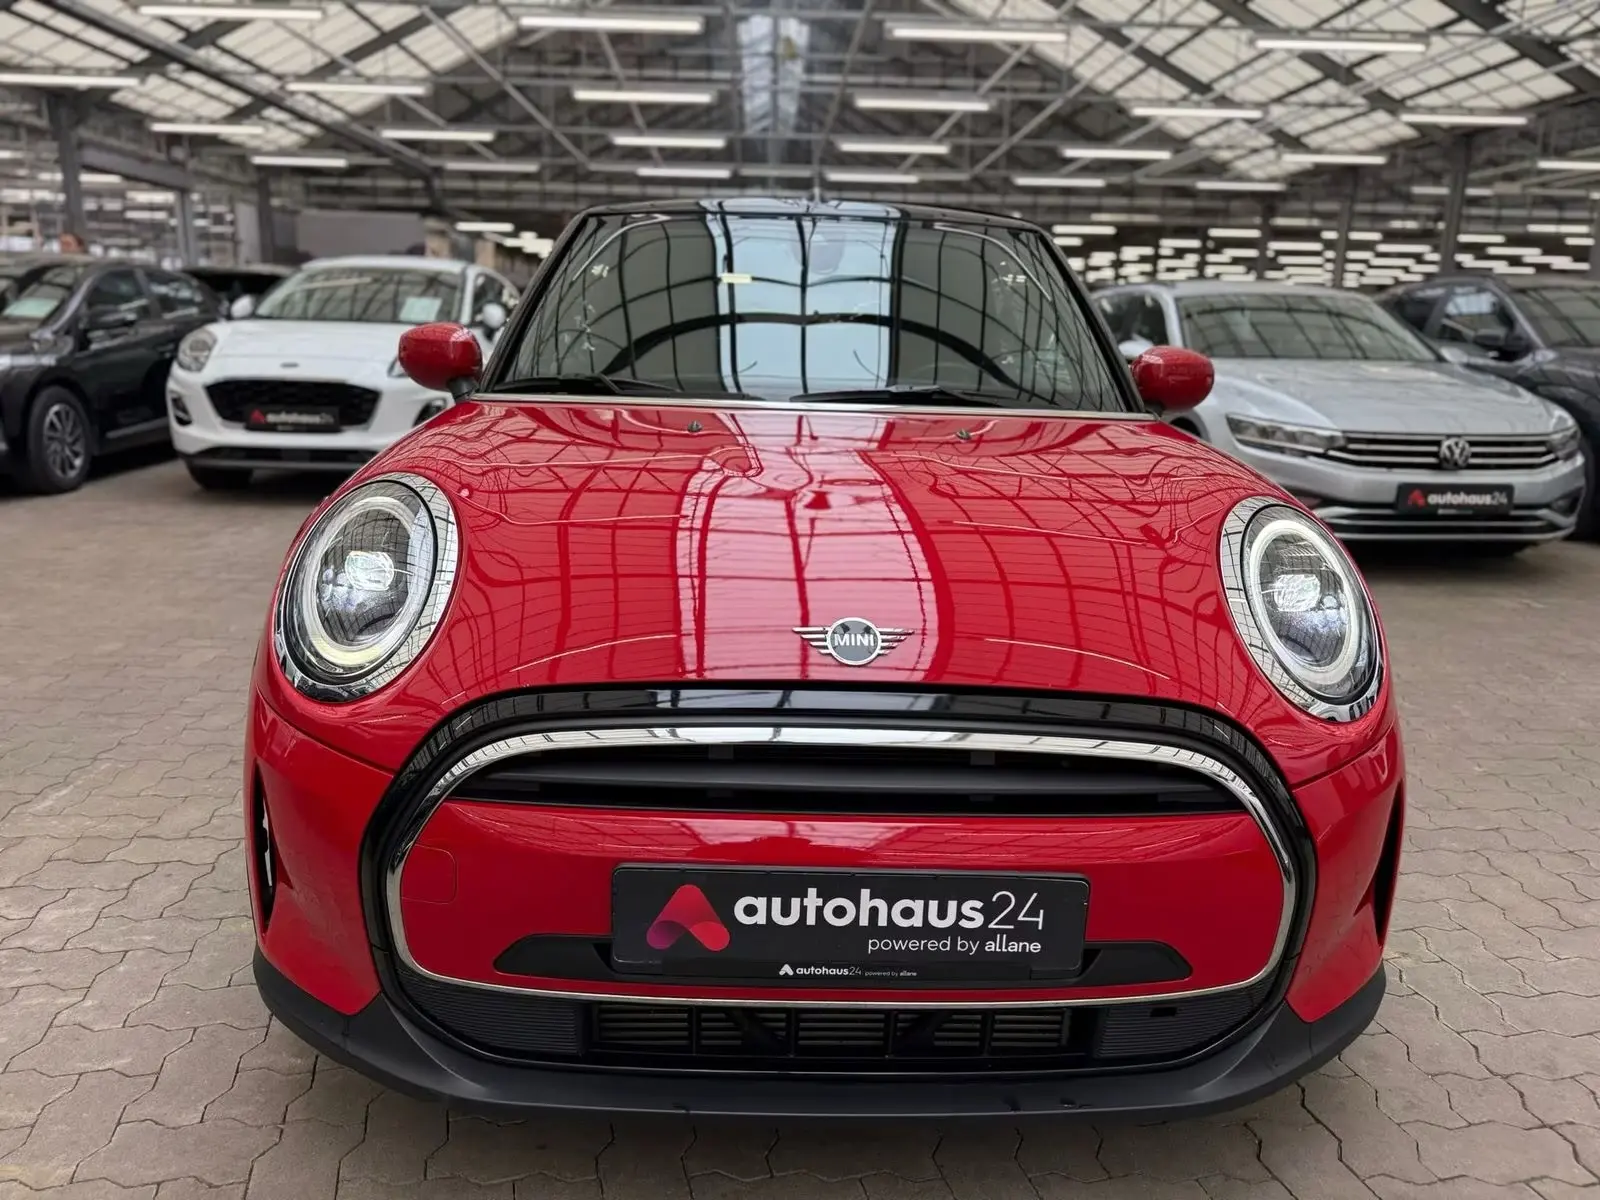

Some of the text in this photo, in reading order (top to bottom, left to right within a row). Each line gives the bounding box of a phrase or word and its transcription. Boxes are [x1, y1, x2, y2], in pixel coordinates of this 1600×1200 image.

[1427, 491, 1508, 505] autohaus24
[834, 633, 875, 646] MINI
[734, 887, 1044, 930] autohaus24
[868, 934, 1042, 956] powered by allane
[796, 966, 862, 976] autohaus24
